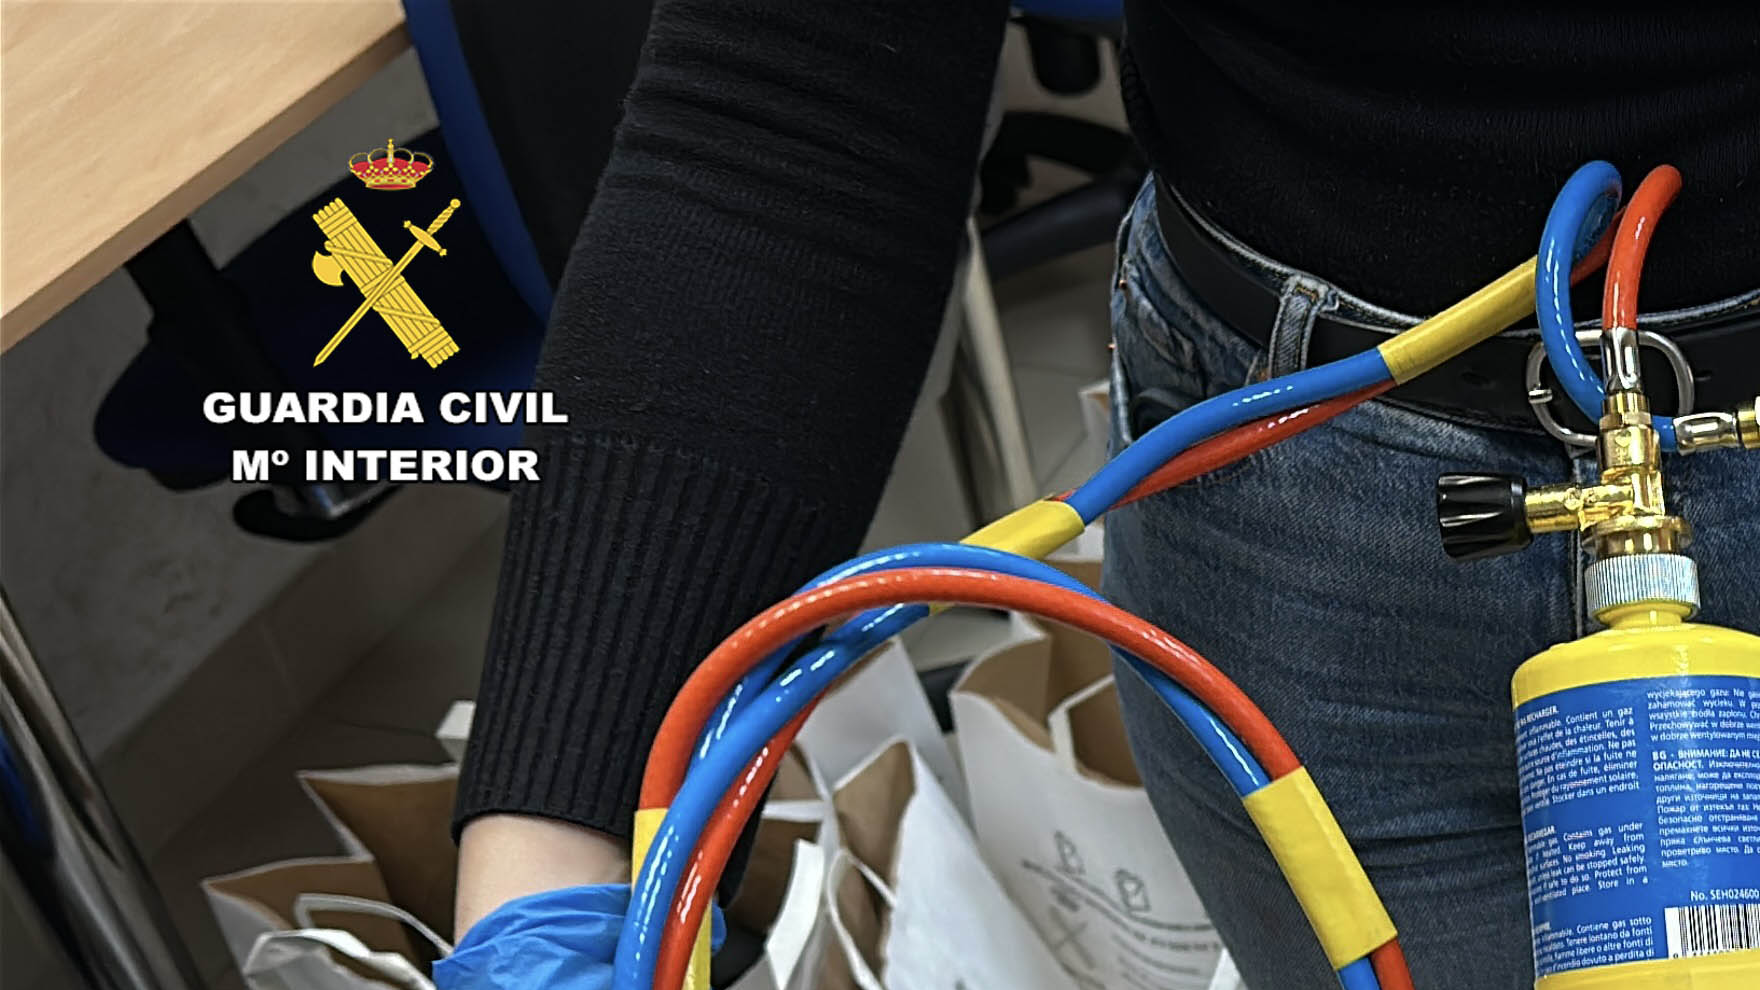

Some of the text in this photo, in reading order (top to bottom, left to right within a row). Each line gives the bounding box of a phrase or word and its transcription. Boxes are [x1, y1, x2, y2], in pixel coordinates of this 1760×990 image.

[1566, 707, 1633, 724] Contient un gaz
[1605, 718, 1626, 729] Tenir
[1620, 728, 1635, 738] des
[1622, 740, 1636, 751] pas
[1604, 750, 1637, 761] fuite ne
[1604, 760, 1638, 771] éliminer
[1596, 781, 1640, 794] un endroit
[1598, 822, 1644, 836] gas under
[1568, 833, 1644, 852] Keep away from
[1562, 844, 1646, 863] No Leaking
[1587, 857, 1618, 870] stopped
[1594, 865, 1647, 879] Protect from
[1598, 877, 1635, 890] Store in
[1690, 889, 1708, 902] No.
[1576, 916, 1652, 934] Contiene gas sotto
[1589, 926, 1653, 943] lontano da fonti
[1603, 935, 1653, 951] altre fonti di
[1614, 947, 1654, 962] perdita di
